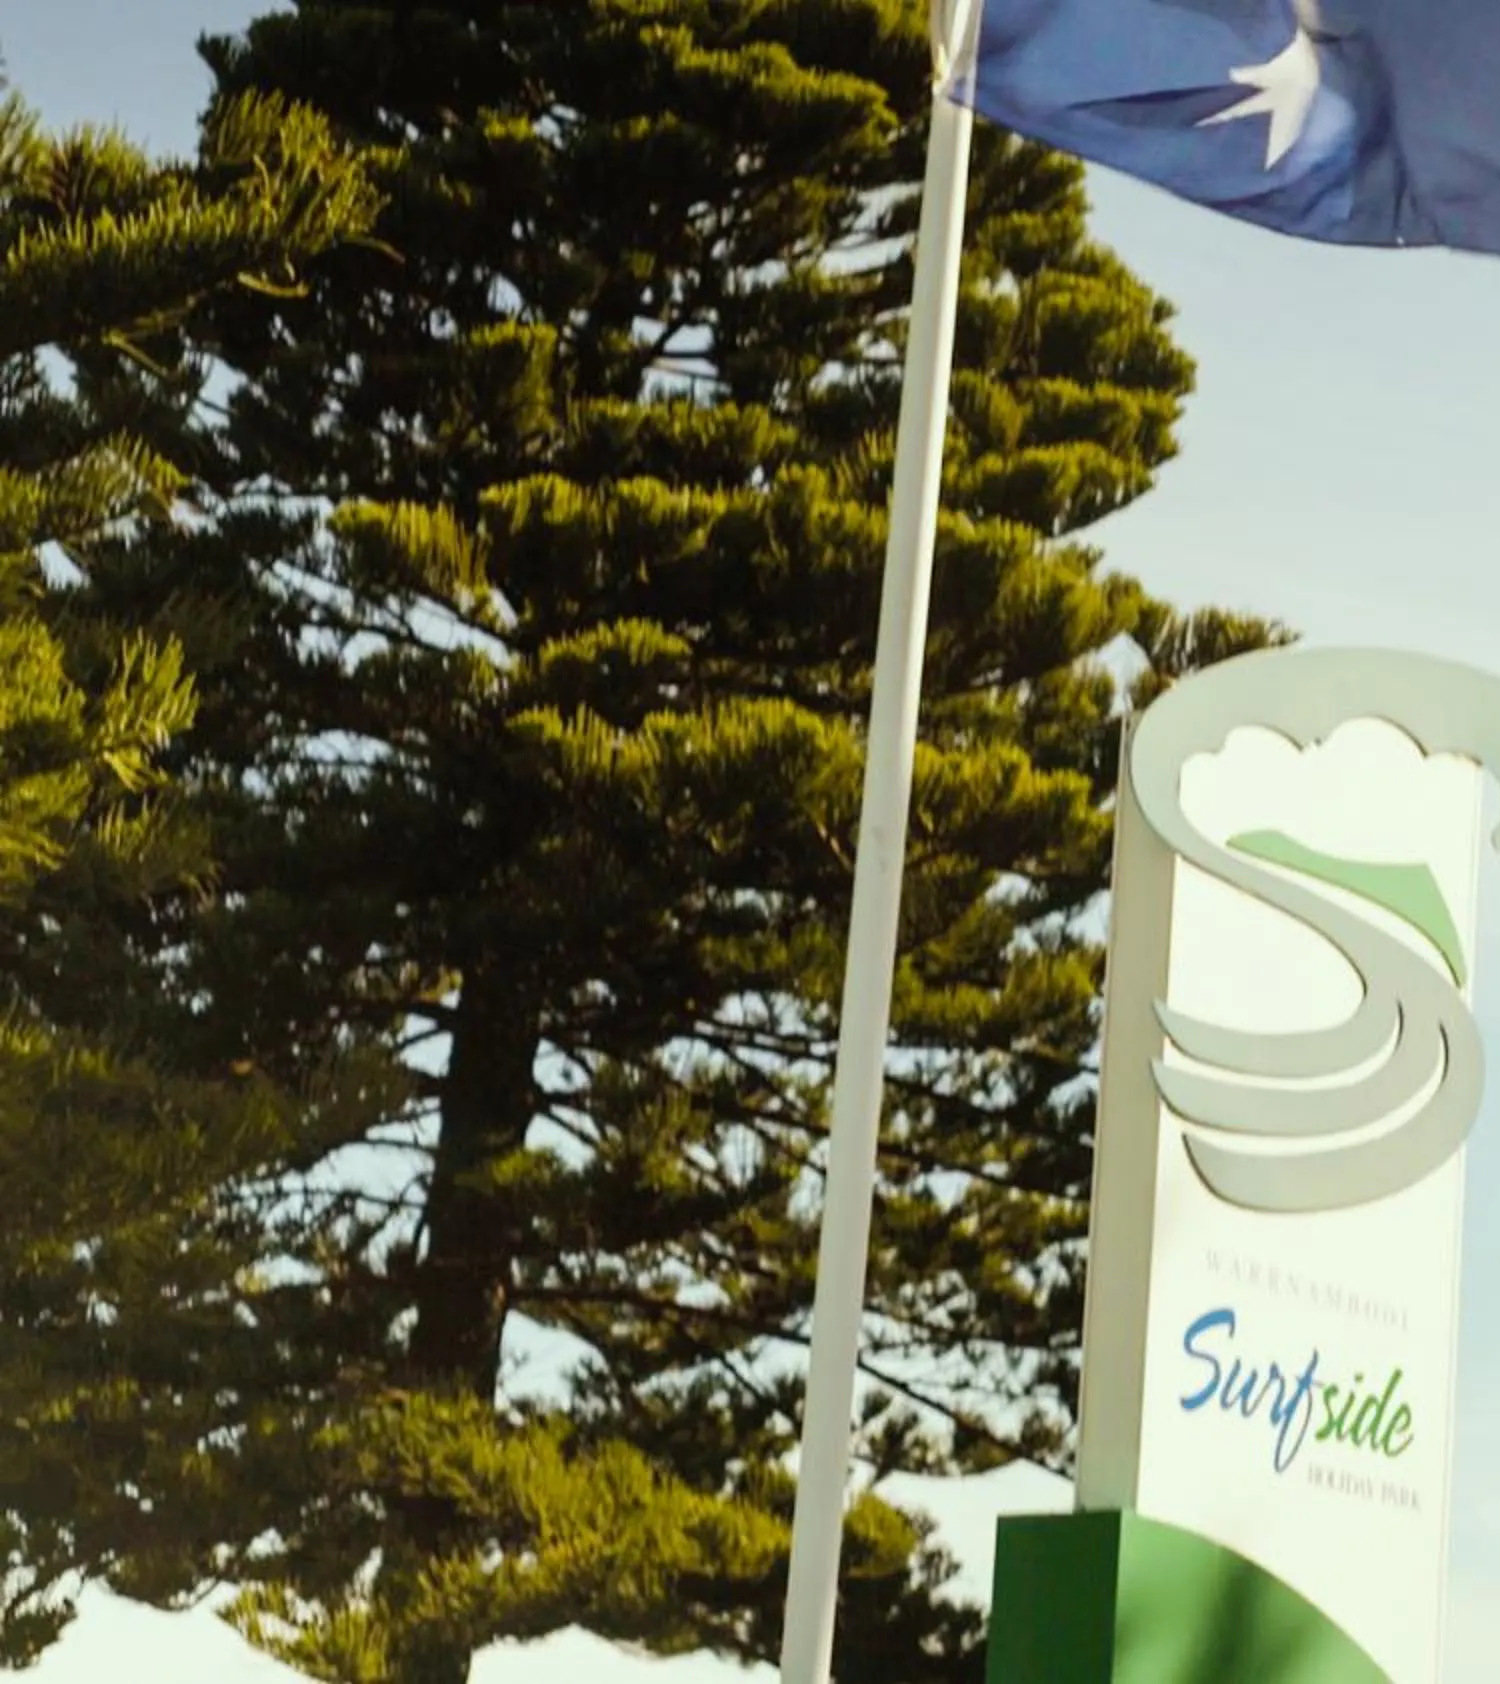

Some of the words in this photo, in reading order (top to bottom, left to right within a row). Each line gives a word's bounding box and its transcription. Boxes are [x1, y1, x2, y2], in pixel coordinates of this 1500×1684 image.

[1180, 1307, 1415, 1474] Surfside
[1307, 1461, 1374, 1500] HOLIDAY
[1381, 1480, 1422, 1514] PARK
